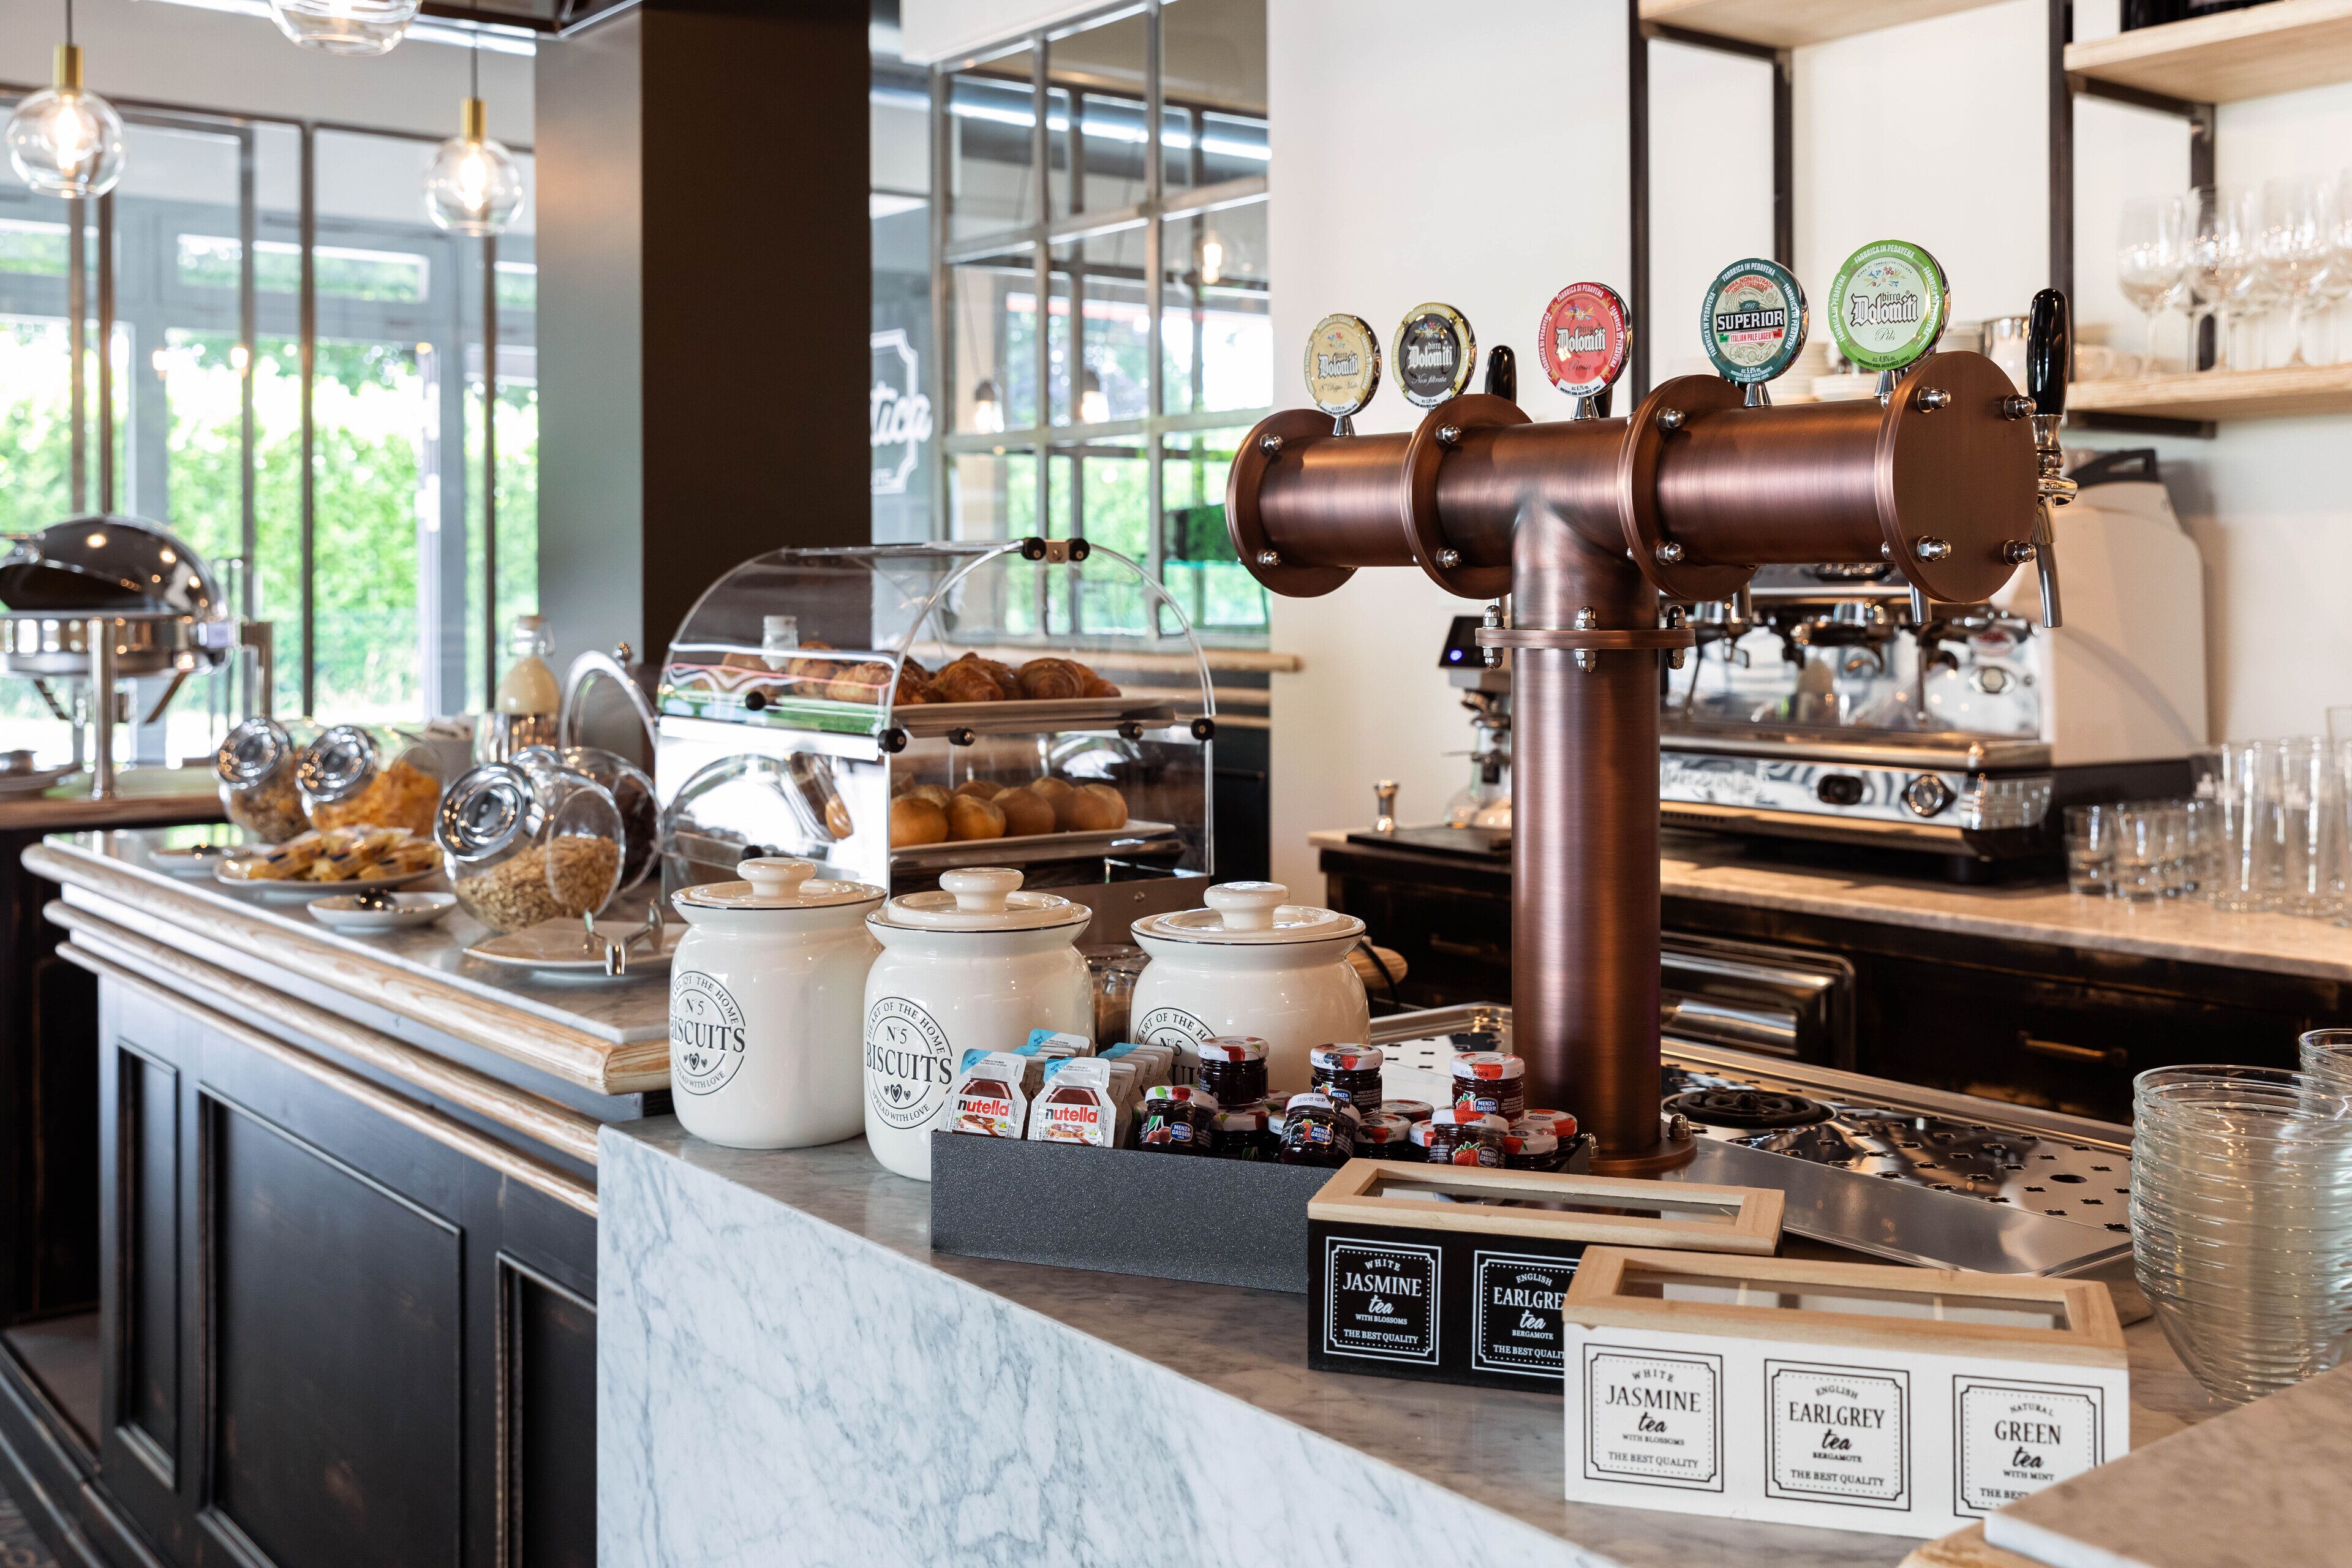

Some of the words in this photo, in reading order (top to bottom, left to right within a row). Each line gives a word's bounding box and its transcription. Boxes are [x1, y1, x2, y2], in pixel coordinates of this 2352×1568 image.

[1854, 246, 1880, 264] FABBRICA
[1887, 244, 1915, 258] PEDAVENA
[1721, 265, 1744, 282] FABBRICA
[1751, 262, 1776, 277] PEDAVENA
[1923, 266, 1938, 295] FABBRICA
[1556, 285, 1577, 303] FABBRICA
[1582, 284, 1604, 298] PEDAVENA
[1725, 281, 1739, 293] BIRRA
[1752, 276, 1774, 289] FILTRATA
[1744, 282, 1768, 292] ITALIANA
[1834, 274, 1847, 305] PEDAVENA
[1782, 283, 1796, 312] FABBRICA
[1882, 291, 1901, 301] birra
[1703, 292, 1716, 321] PEDAVENA
[1850, 292, 1918, 327] Dolomiti
[1540, 312, 1551, 340] PEDAVENA
[1610, 305, 1621, 332] FABBRICA
[1717, 310, 1784, 330] SUPERIOR
[1555, 326, 1607, 355] Dolomiti
[1703, 328, 1717, 356] FABBRICA
[1730, 333, 1747, 342] ITALIAN
[1747, 332, 1757, 341] PALE
[1758, 332, 1771, 341] LAGER
[1874, 328, 1895, 342] Pils
[1428, 342, 1441, 350] birra
[1610, 339, 1623, 368] PEDAVENA
[1318, 353, 1359, 379] Dolomiti
[1407, 344, 1453, 369] Dolomiti
[1539, 347, 1551, 373] FABBRICA
[1411, 374, 1427, 385] Non
[1427, 375, 1447, 387] filtrata
[697, 976, 714, 992] THE
[715, 990, 739, 1025] HOME
[868, 1006, 881, 1039] HEART
[883, 1002, 894, 1012] OF
[898, 1003, 919, 1019] THE
[919, 1017, 946, 1055] HOME
[1137, 1017, 1153, 1045] EART
[1156, 1012, 1167, 1023] OF
[1172, 1013, 1195, 1031] THE
[866, 1041, 952, 1085] BISCUITS
[706, 1071, 726, 1087] LOVE
[872, 1089, 890, 1117] SPREAD
[890, 1112, 909, 1121] WITH
[909, 1104, 930, 1120] LOVE
[957, 1099, 1010, 1117] nutella
[1045, 1107, 1098, 1123] nutella
[1311, 1131, 1331, 1140] GASSER
[1313, 1126, 1330, 1135] MENZ&
[1364, 1259, 1401, 1272] WHITE
[1342, 1272, 1422, 1297] JASMINE
[1515, 1273, 1553, 1287] ENGLISH
[1368, 1294, 1394, 1314] tea
[1355, 1313, 1373, 1322] WITH
[1373, 1316, 1408, 1325] BLOSSOMS
[1520, 1309, 1547, 1330] tea
[1343, 1329, 1361, 1338] THE
[1362, 1330, 1382, 1340] BEST
[1382, 1333, 1419, 1344] QUALITY
[1512, 1329, 1554, 1340] BERGAMOTE
[1493, 1344, 1511, 1354] THE
[1512, 1346, 1533, 1356] BEST
[1534, 1349, 1565, 1359] QUALIT
[1632, 1368, 1675, 1382] WHITE
[1605, 1384, 1701, 1413] JASMINE
[1815, 1385, 1859, 1400] ENGLISH
[1789, 1401, 1885, 1429] EARLGREY
[2010, 1402, 2054, 1417] NATURAL
[1638, 1411, 1667, 1433] tea
[1994, 1419, 2061, 1445] GREEN
[1623, 1433, 1643, 1442] WITH
[1645, 1436, 1684, 1446] BLOSSOMS
[1822, 1428, 1852, 1450] tea
[1608, 1451, 1628, 1461] THE
[1630, 1453, 1654, 1464] BEST
[1656, 1455, 1699, 1468] QUALITY
[1812, 1452, 1863, 1463] BERGAMOTE
[2012, 1445, 2044, 1468] tea
[1790, 1469, 1811, 1479] THE
[1813, 1471, 1838, 1482] BEST
[1840, 1474, 1885, 1487] QUALITY
[2003, 1469, 2027, 1479] WITH
[2030, 1472, 2054, 1481] MINT
[1979, 1487, 2001, 1498] THE
